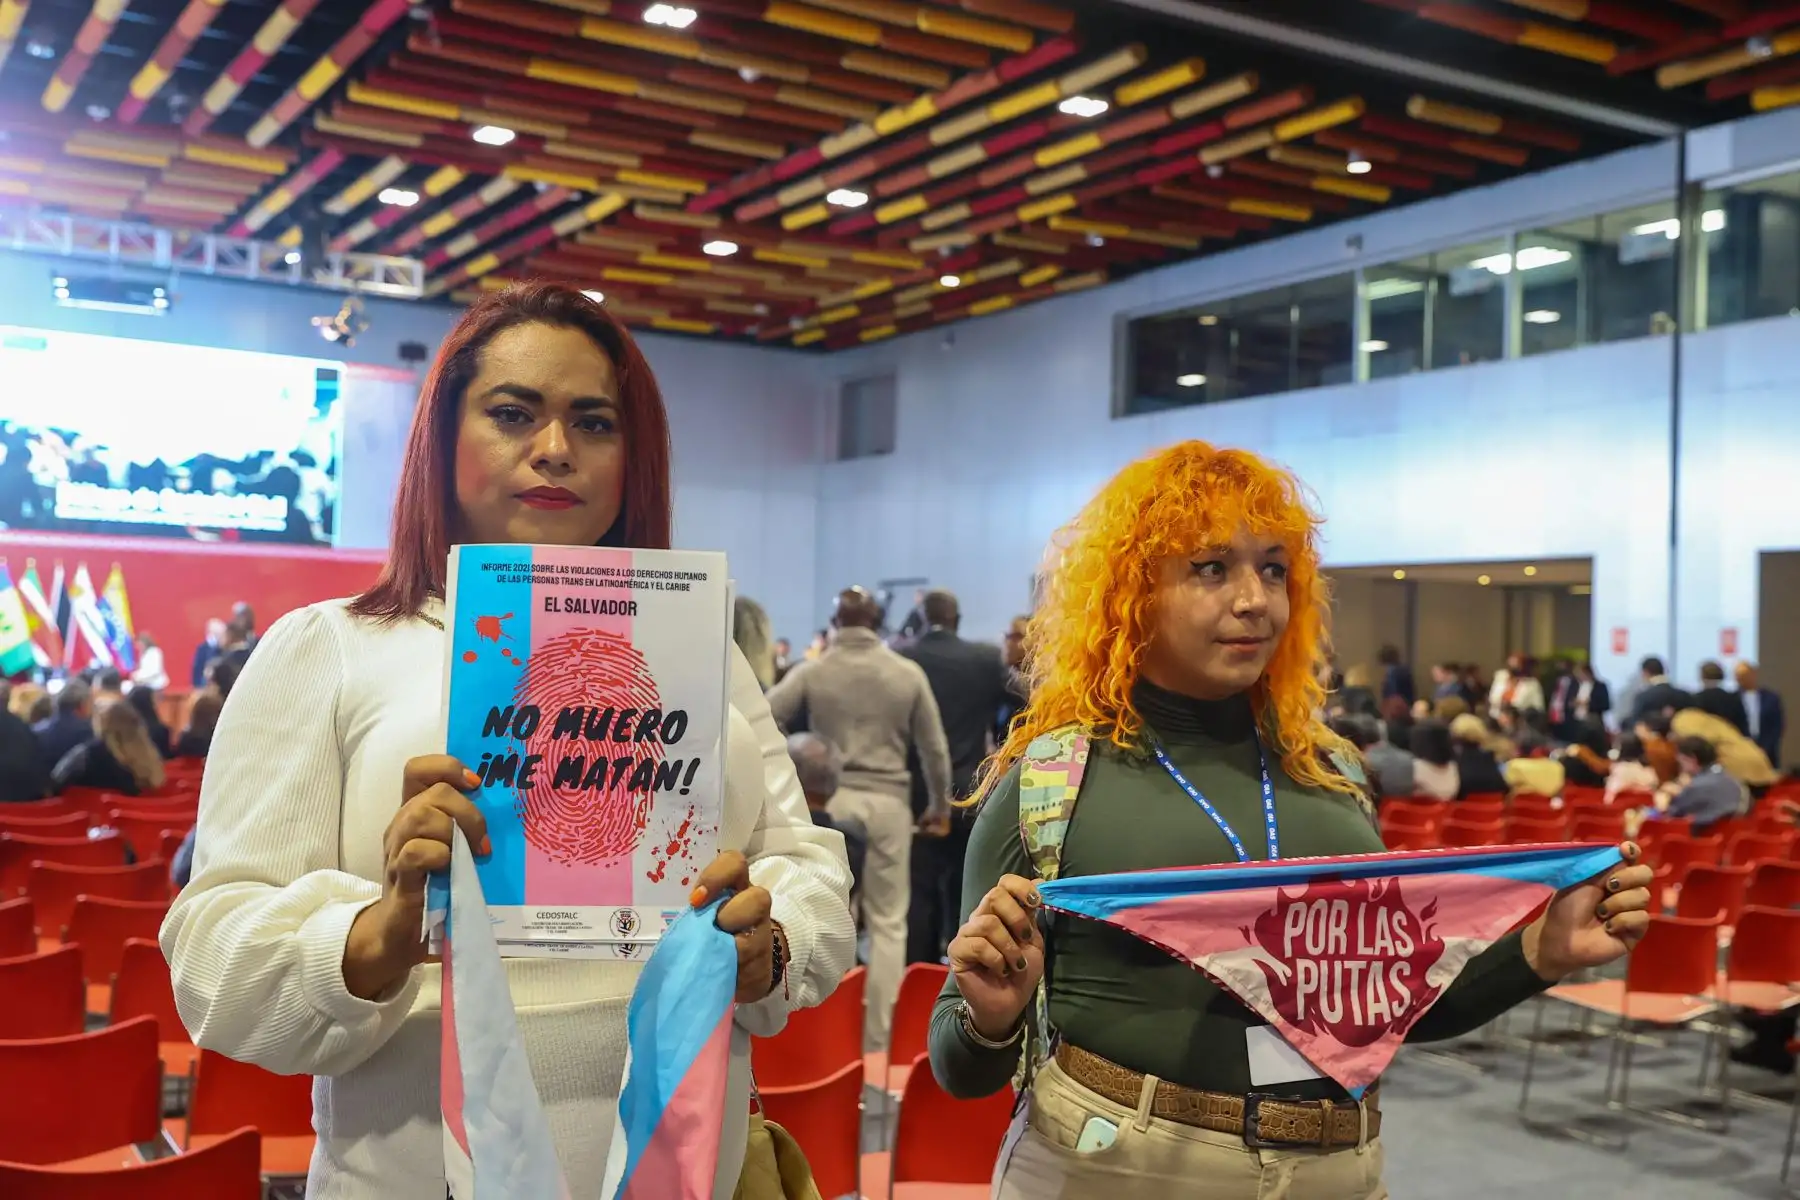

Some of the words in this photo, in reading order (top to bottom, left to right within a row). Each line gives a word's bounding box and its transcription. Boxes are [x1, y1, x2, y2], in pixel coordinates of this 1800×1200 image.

[481, 563, 513, 572] INFORME
[531, 564, 555, 573] SOBRE
[556, 565, 569, 574] LAS
[571, 566, 615, 577] VIOLACIONES
[616, 568, 621, 577] A
[622, 568, 635, 578] LOS
[636, 569, 673, 580] DERECHOS
[674, 571, 708, 581] HUMANOS
[497, 574, 507, 583] DE
[508, 575, 521, 584] LAS
[522, 575, 560, 585] PERSONAS
[561, 576, 584, 586] TRANS
[585, 577, 594, 587] EN
[595, 578, 649, 590] LATINOAMÉRICA
[650, 581, 656, 590] Y
[656, 582, 664, 590] EL
[665, 582, 691, 592] CARIBE
[544, 596, 561, 613] EL
[564, 597, 638, 617] SALVADOR
[482, 704, 541, 741] NO
[551, 705, 689, 745] MUERO
[476, 752, 542, 790] ¡ME
[551, 755, 701, 796] MATAN!
[536, 911, 578, 920] CEDOSTALC
[1283, 898, 1349, 959] POR
[1357, 902, 1415, 958] LAS
[1296, 958, 1412, 1026] PUTAS
